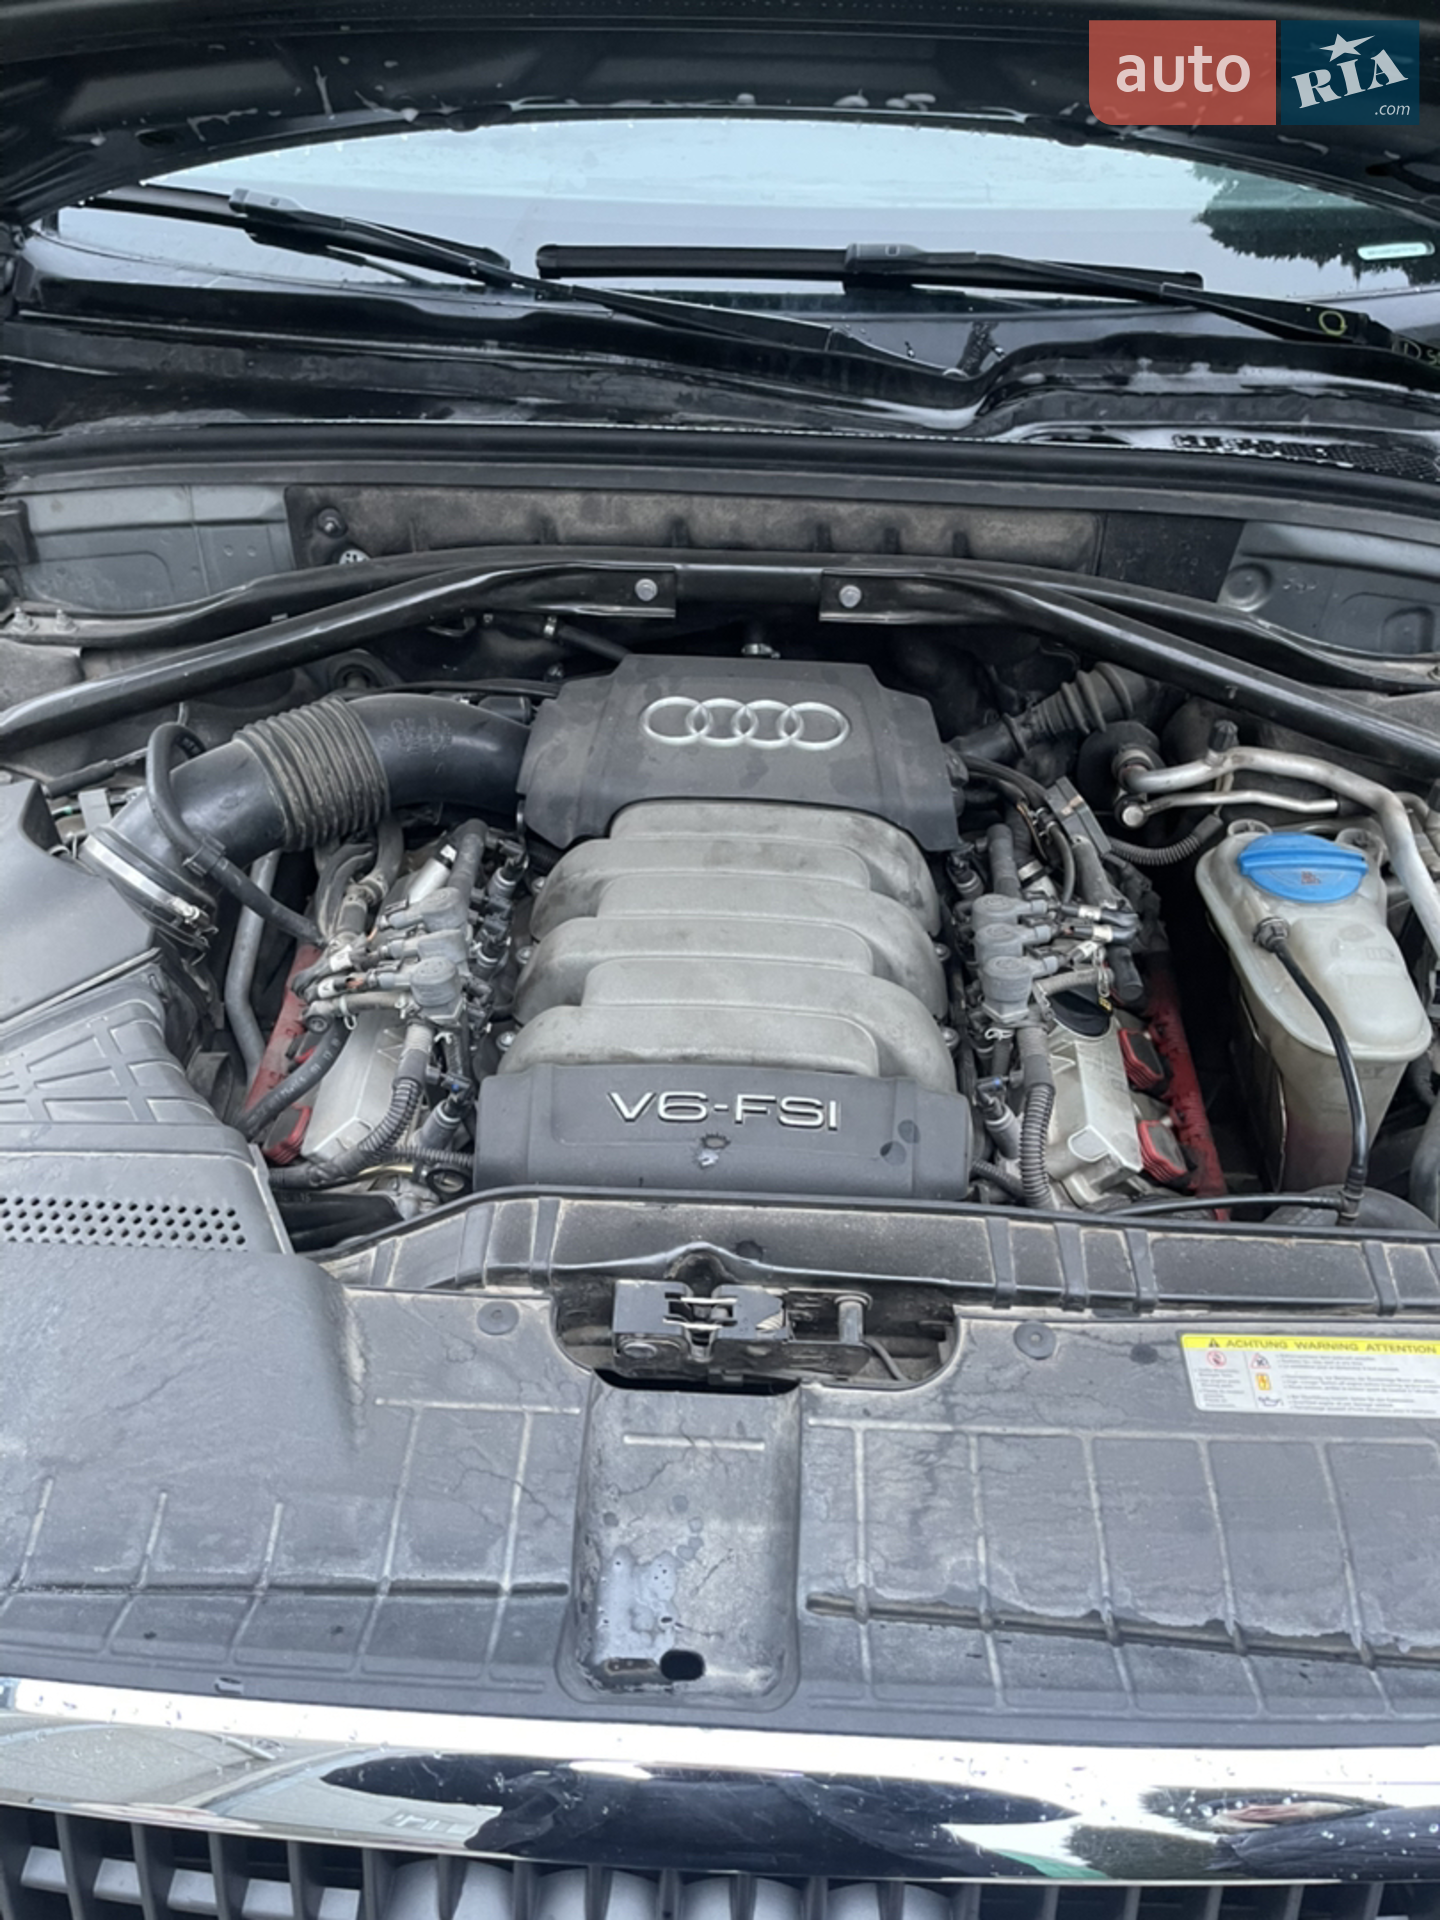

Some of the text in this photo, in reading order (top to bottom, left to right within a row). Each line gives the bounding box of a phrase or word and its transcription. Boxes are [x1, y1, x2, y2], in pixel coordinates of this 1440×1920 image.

[608, 1090, 840, 1131] V6-FSI
[1225, 1339, 1437, 1354] ACHTUNG WARNING ATTENTION
